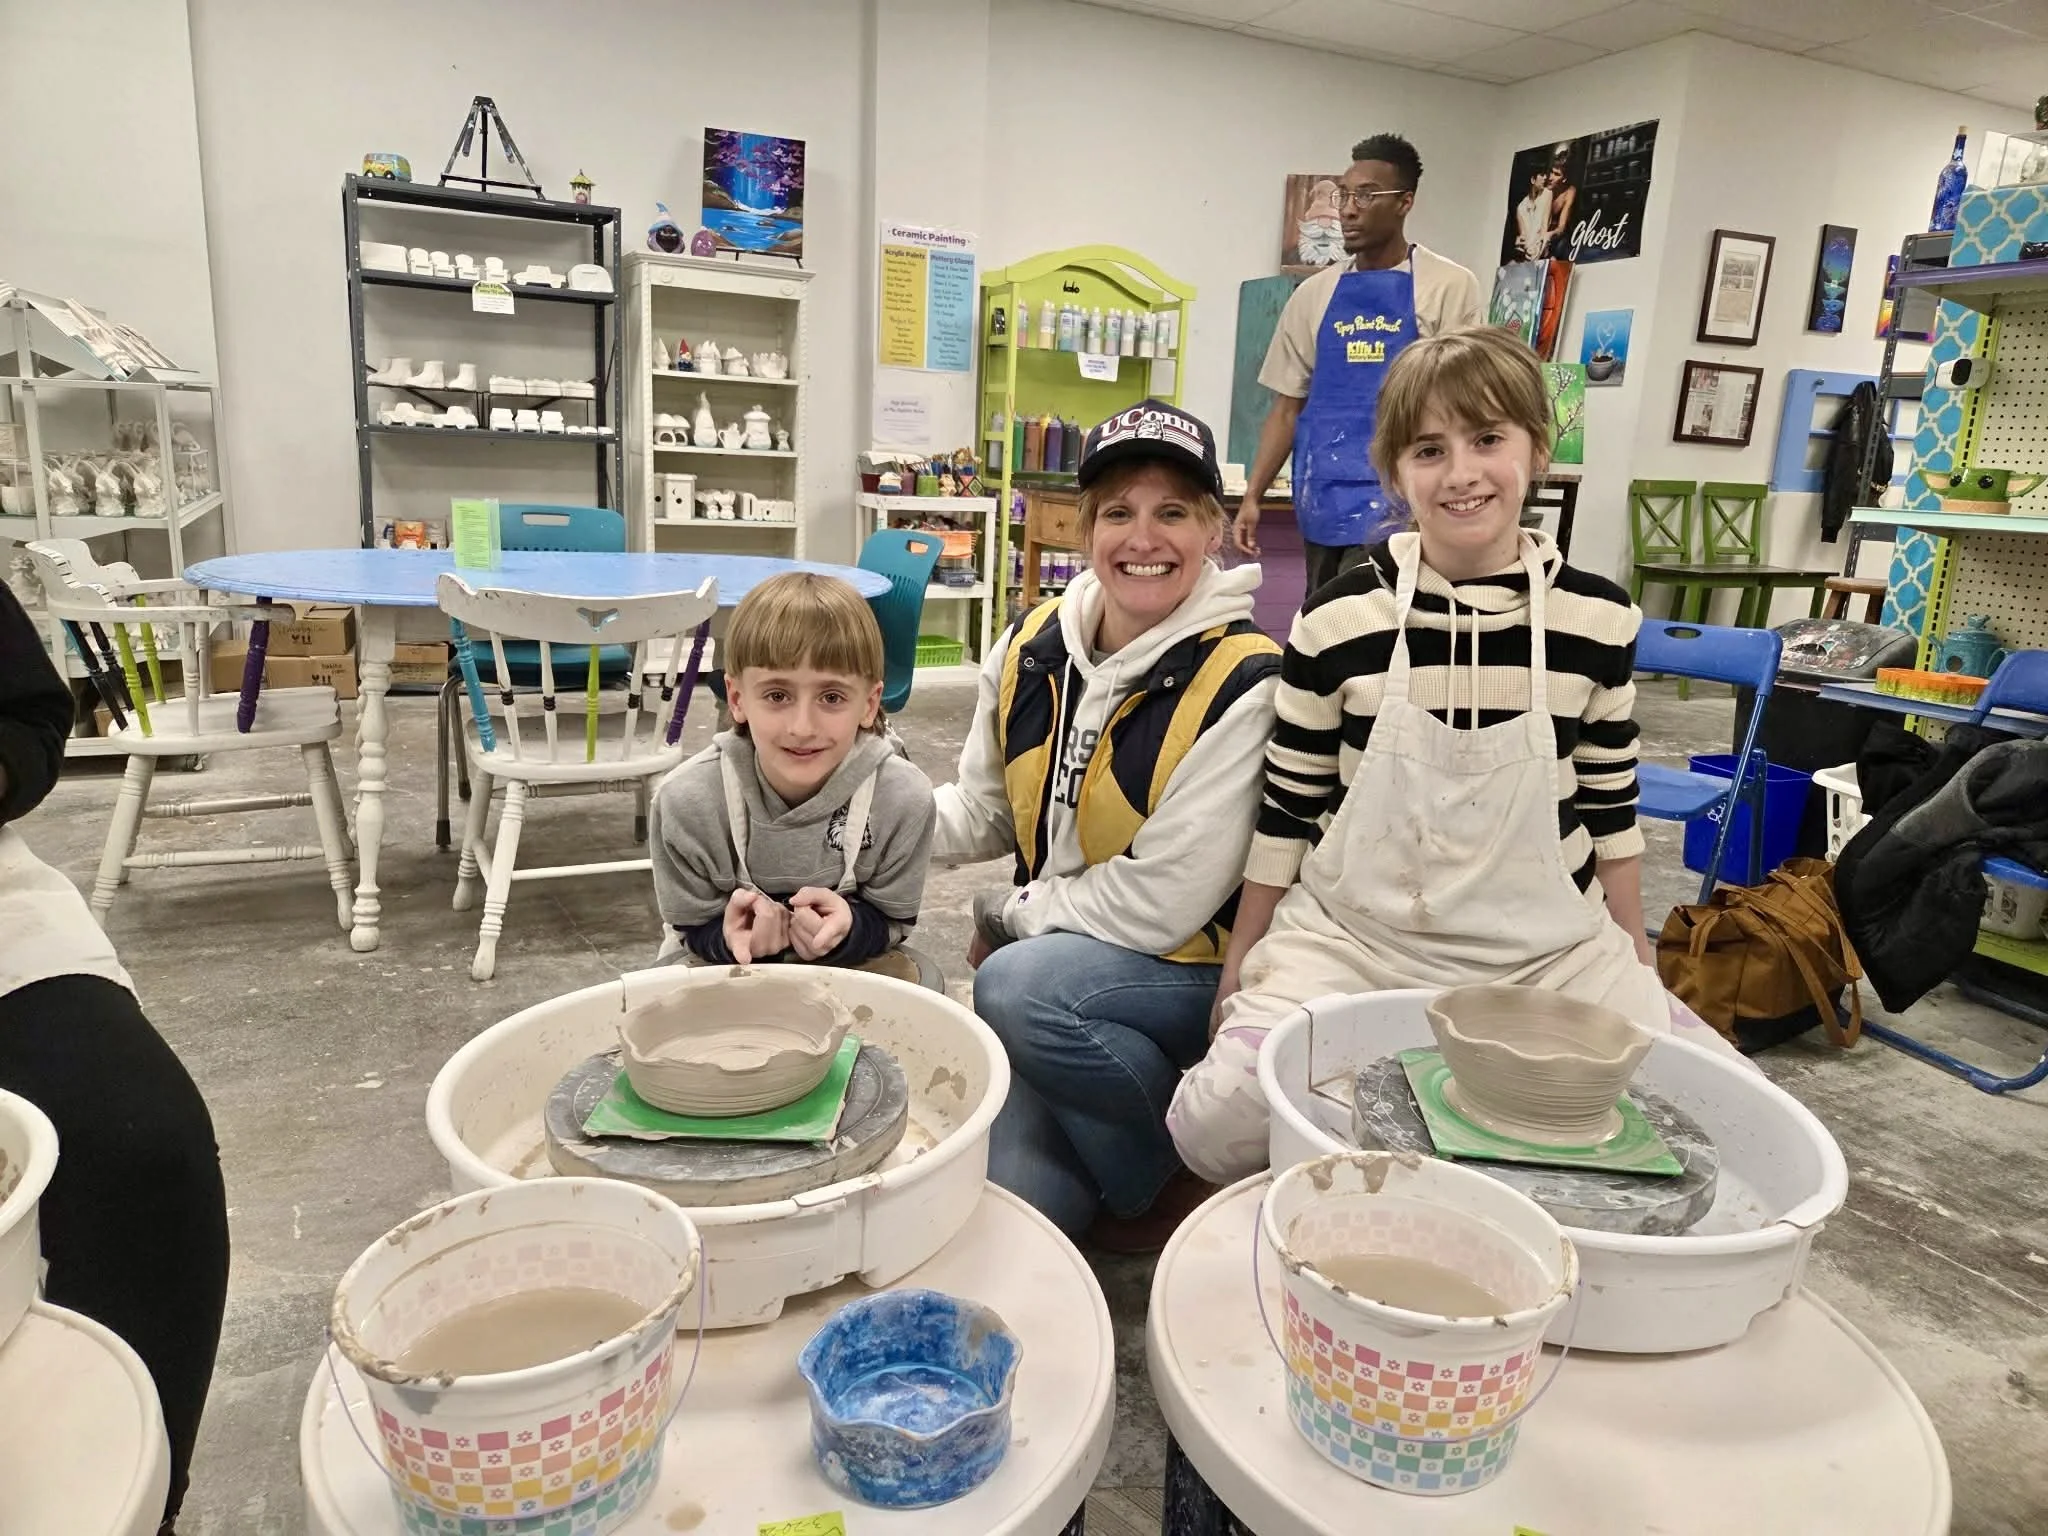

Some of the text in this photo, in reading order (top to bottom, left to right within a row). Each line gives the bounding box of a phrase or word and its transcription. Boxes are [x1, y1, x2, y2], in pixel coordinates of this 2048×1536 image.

[892, 228, 928, 241] Ceramic
[929, 233, 967, 247] Painting
[906, 250, 926, 260] Paints
[1354, 315, 1375, 331] Paint
[1375, 315, 1402, 332] Brush
[1100, 406, 1201, 439] UConn
